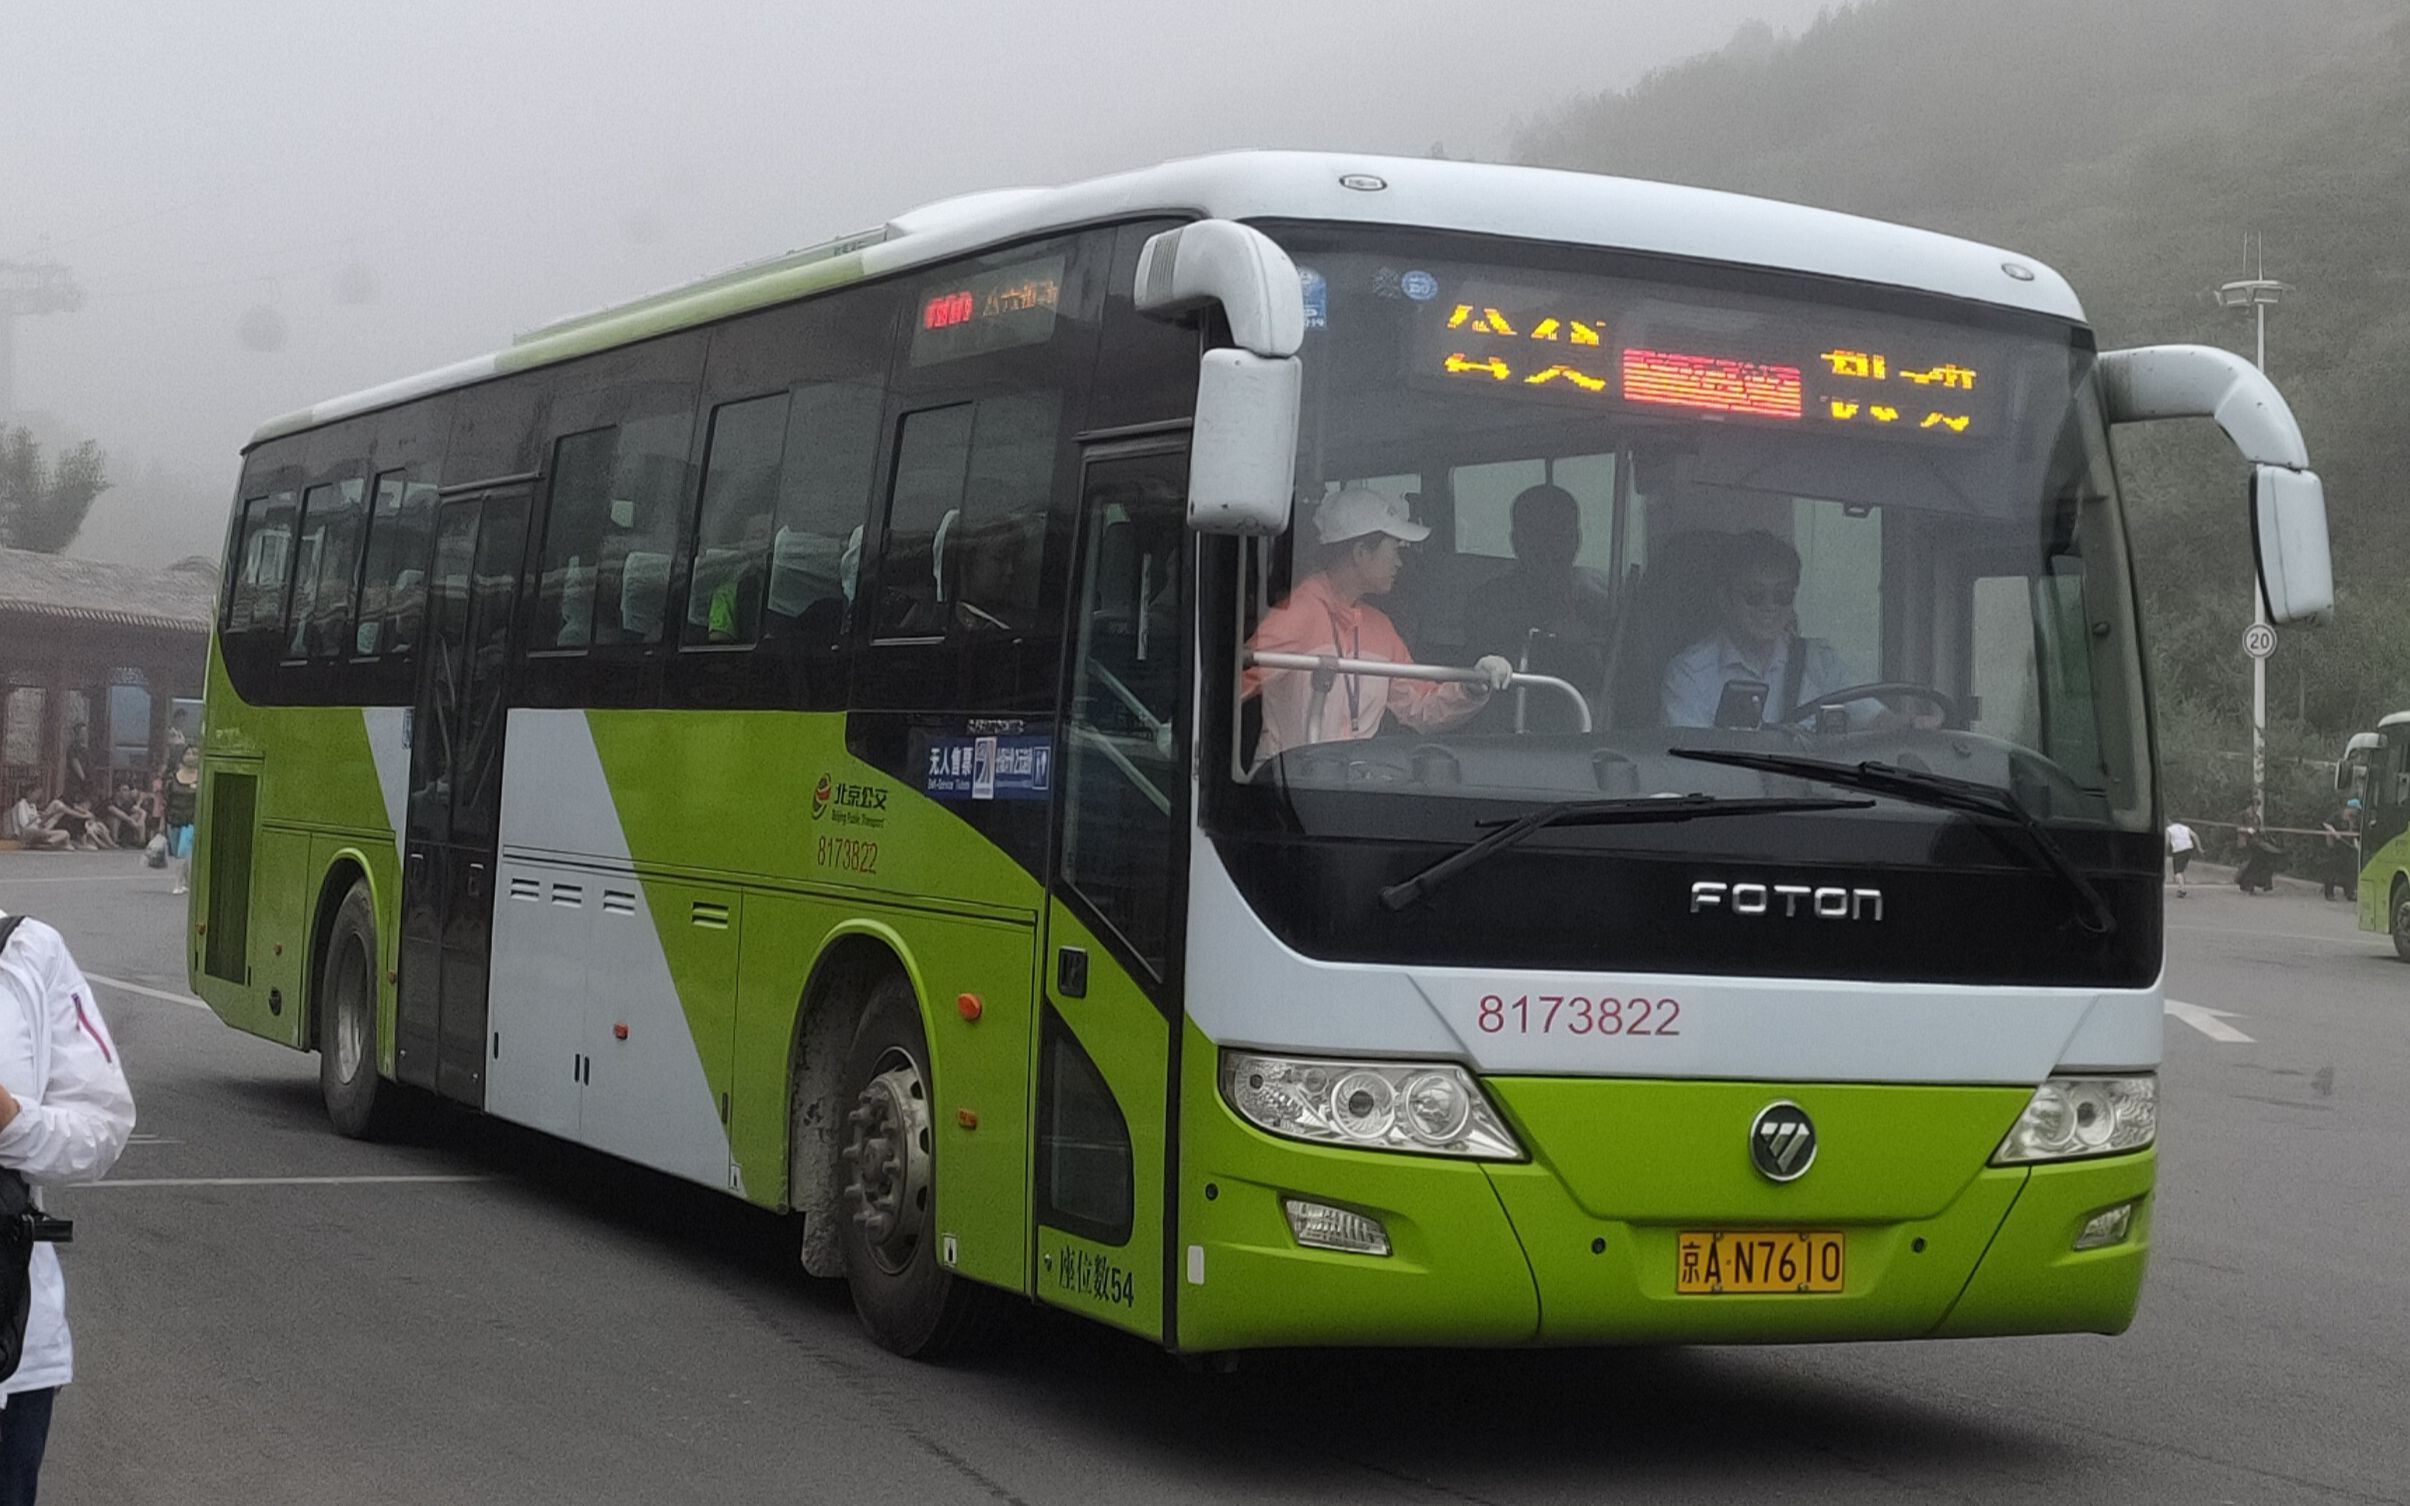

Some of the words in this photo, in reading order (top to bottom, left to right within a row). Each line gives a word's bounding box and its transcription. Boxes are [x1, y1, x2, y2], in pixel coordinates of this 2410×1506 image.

[2250, 633, 2270, 649] 20
[833, 783, 888, 810] 北京公交
[818, 835, 878, 874] 8173822
[1690, 882, 1883, 921] FOTON
[1478, 995, 1680, 1036] 8173822
